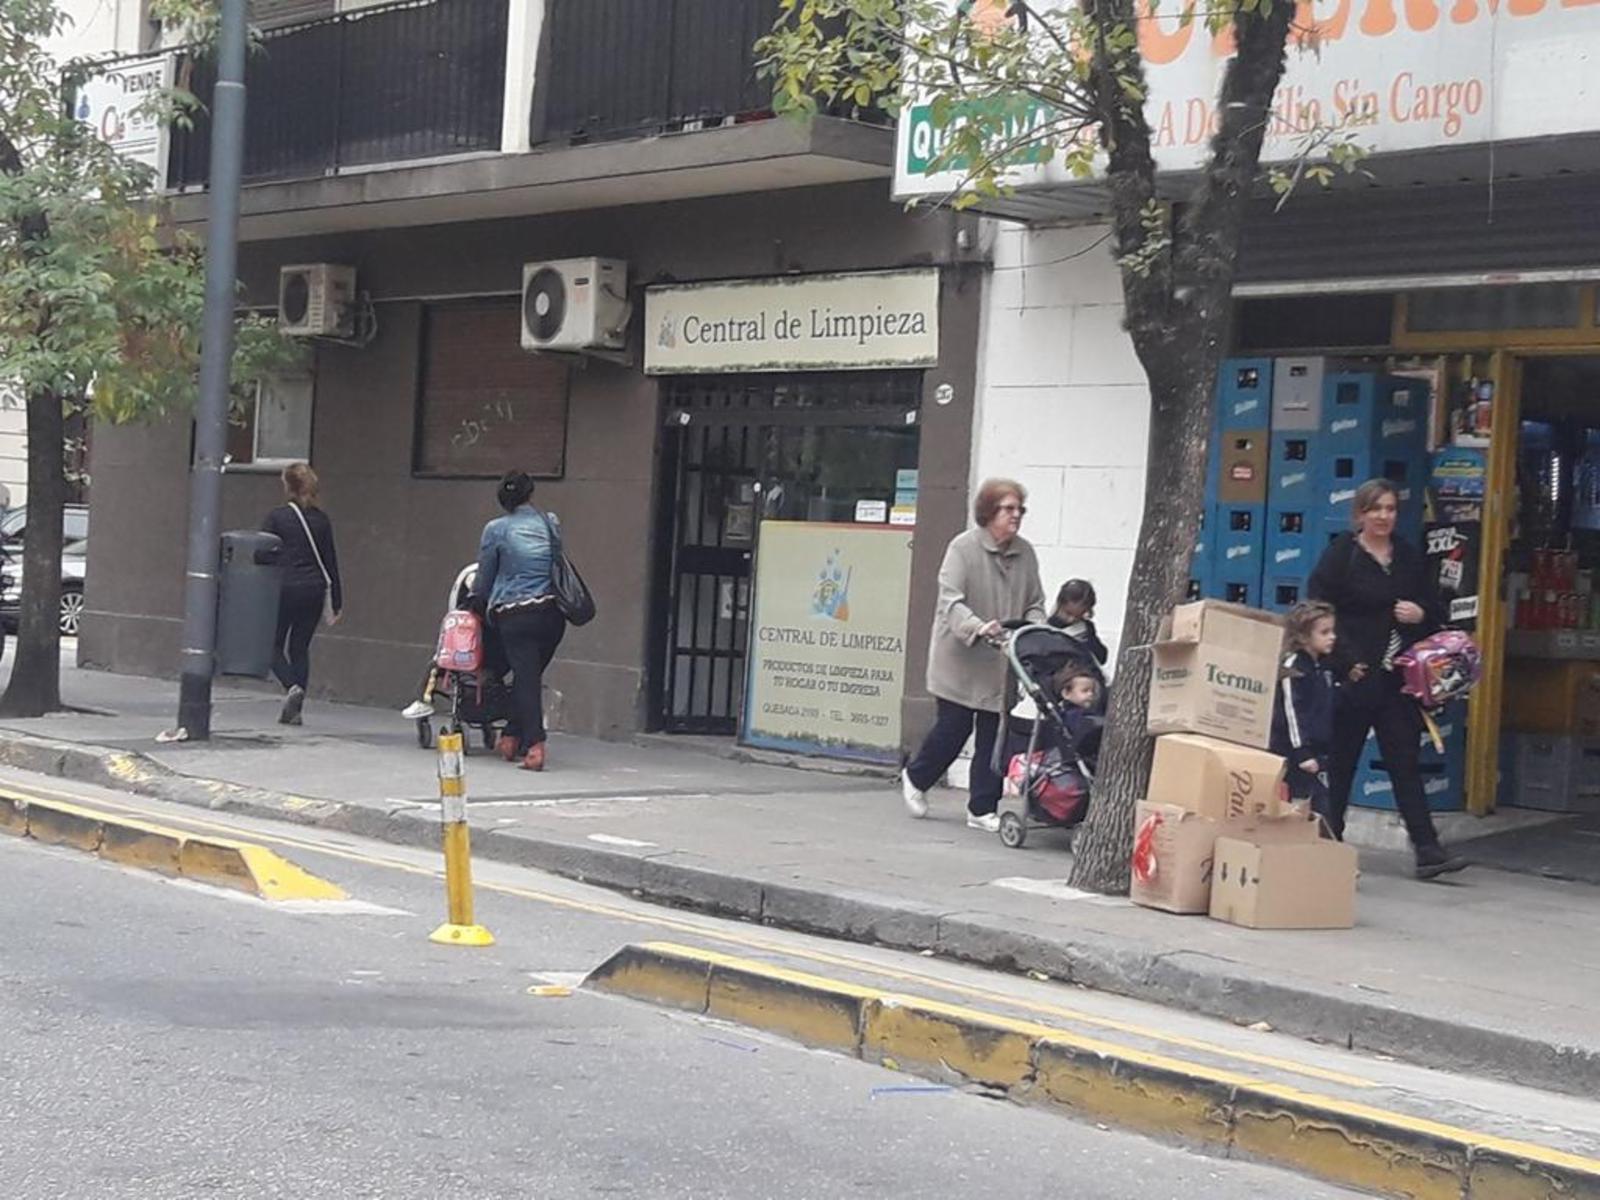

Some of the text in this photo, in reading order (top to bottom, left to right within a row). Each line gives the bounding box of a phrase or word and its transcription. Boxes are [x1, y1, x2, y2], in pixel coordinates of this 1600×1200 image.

[1151, 101, 1175, 147] A
[1333, 78, 1380, 128] Sin
[1389, 71, 1484, 138] Cargo
[683, 304, 927, 345] Central de Limpieza
[1425, 536, 1461, 555] XXL
[758, 626, 904, 653] CENTRAL DE LIMPIEZA
[762, 659, 814, 675] PRODUCTOS
[815, 663, 828, 676] DE
[869, 668, 895, 682] PARA
[1205, 662, 1264, 695] Terma
[785, 677, 817, 690] HOGAR
[818, 679, 827, 691] O
[827, 680, 839, 692] TU
